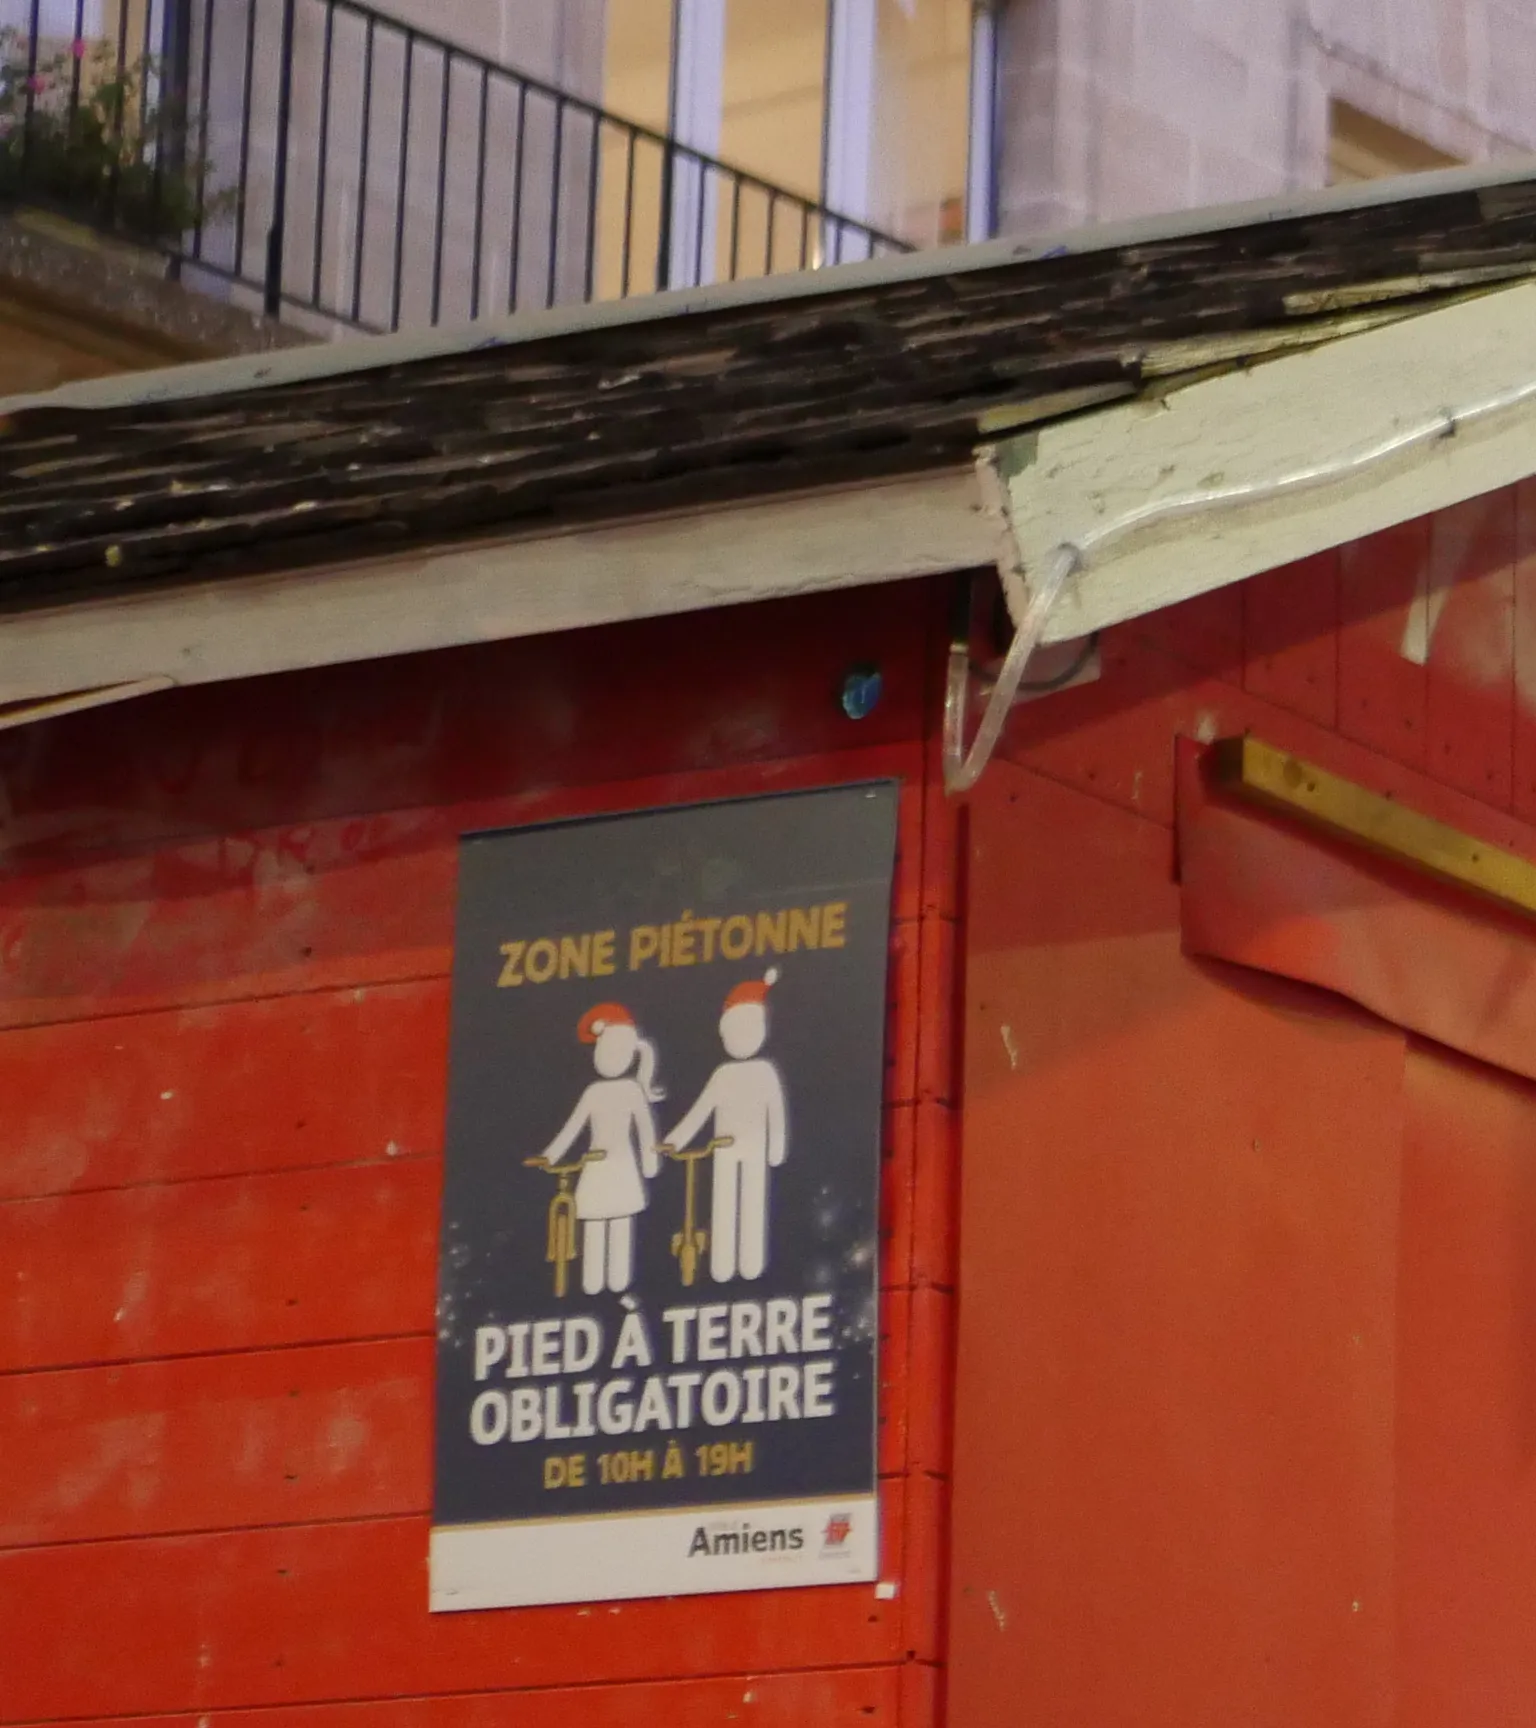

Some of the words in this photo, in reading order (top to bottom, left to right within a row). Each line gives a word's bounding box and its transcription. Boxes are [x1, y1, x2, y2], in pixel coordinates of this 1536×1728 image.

[497, 931, 615, 987] ZONE
[630, 902, 848, 970] PIÉTONNE
[474, 1318, 600, 1381] PIED
[611, 1298, 652, 1369] À
[664, 1296, 832, 1362] TERRE
[469, 1362, 834, 1445] OBLIGATOIRE
[543, 1452, 586, 1488] DE
[597, 1447, 653, 1483] 10H
[662, 1438, 686, 1479] À
[695, 1441, 752, 1476] 19H
[687, 1522, 805, 1558] Amiens
